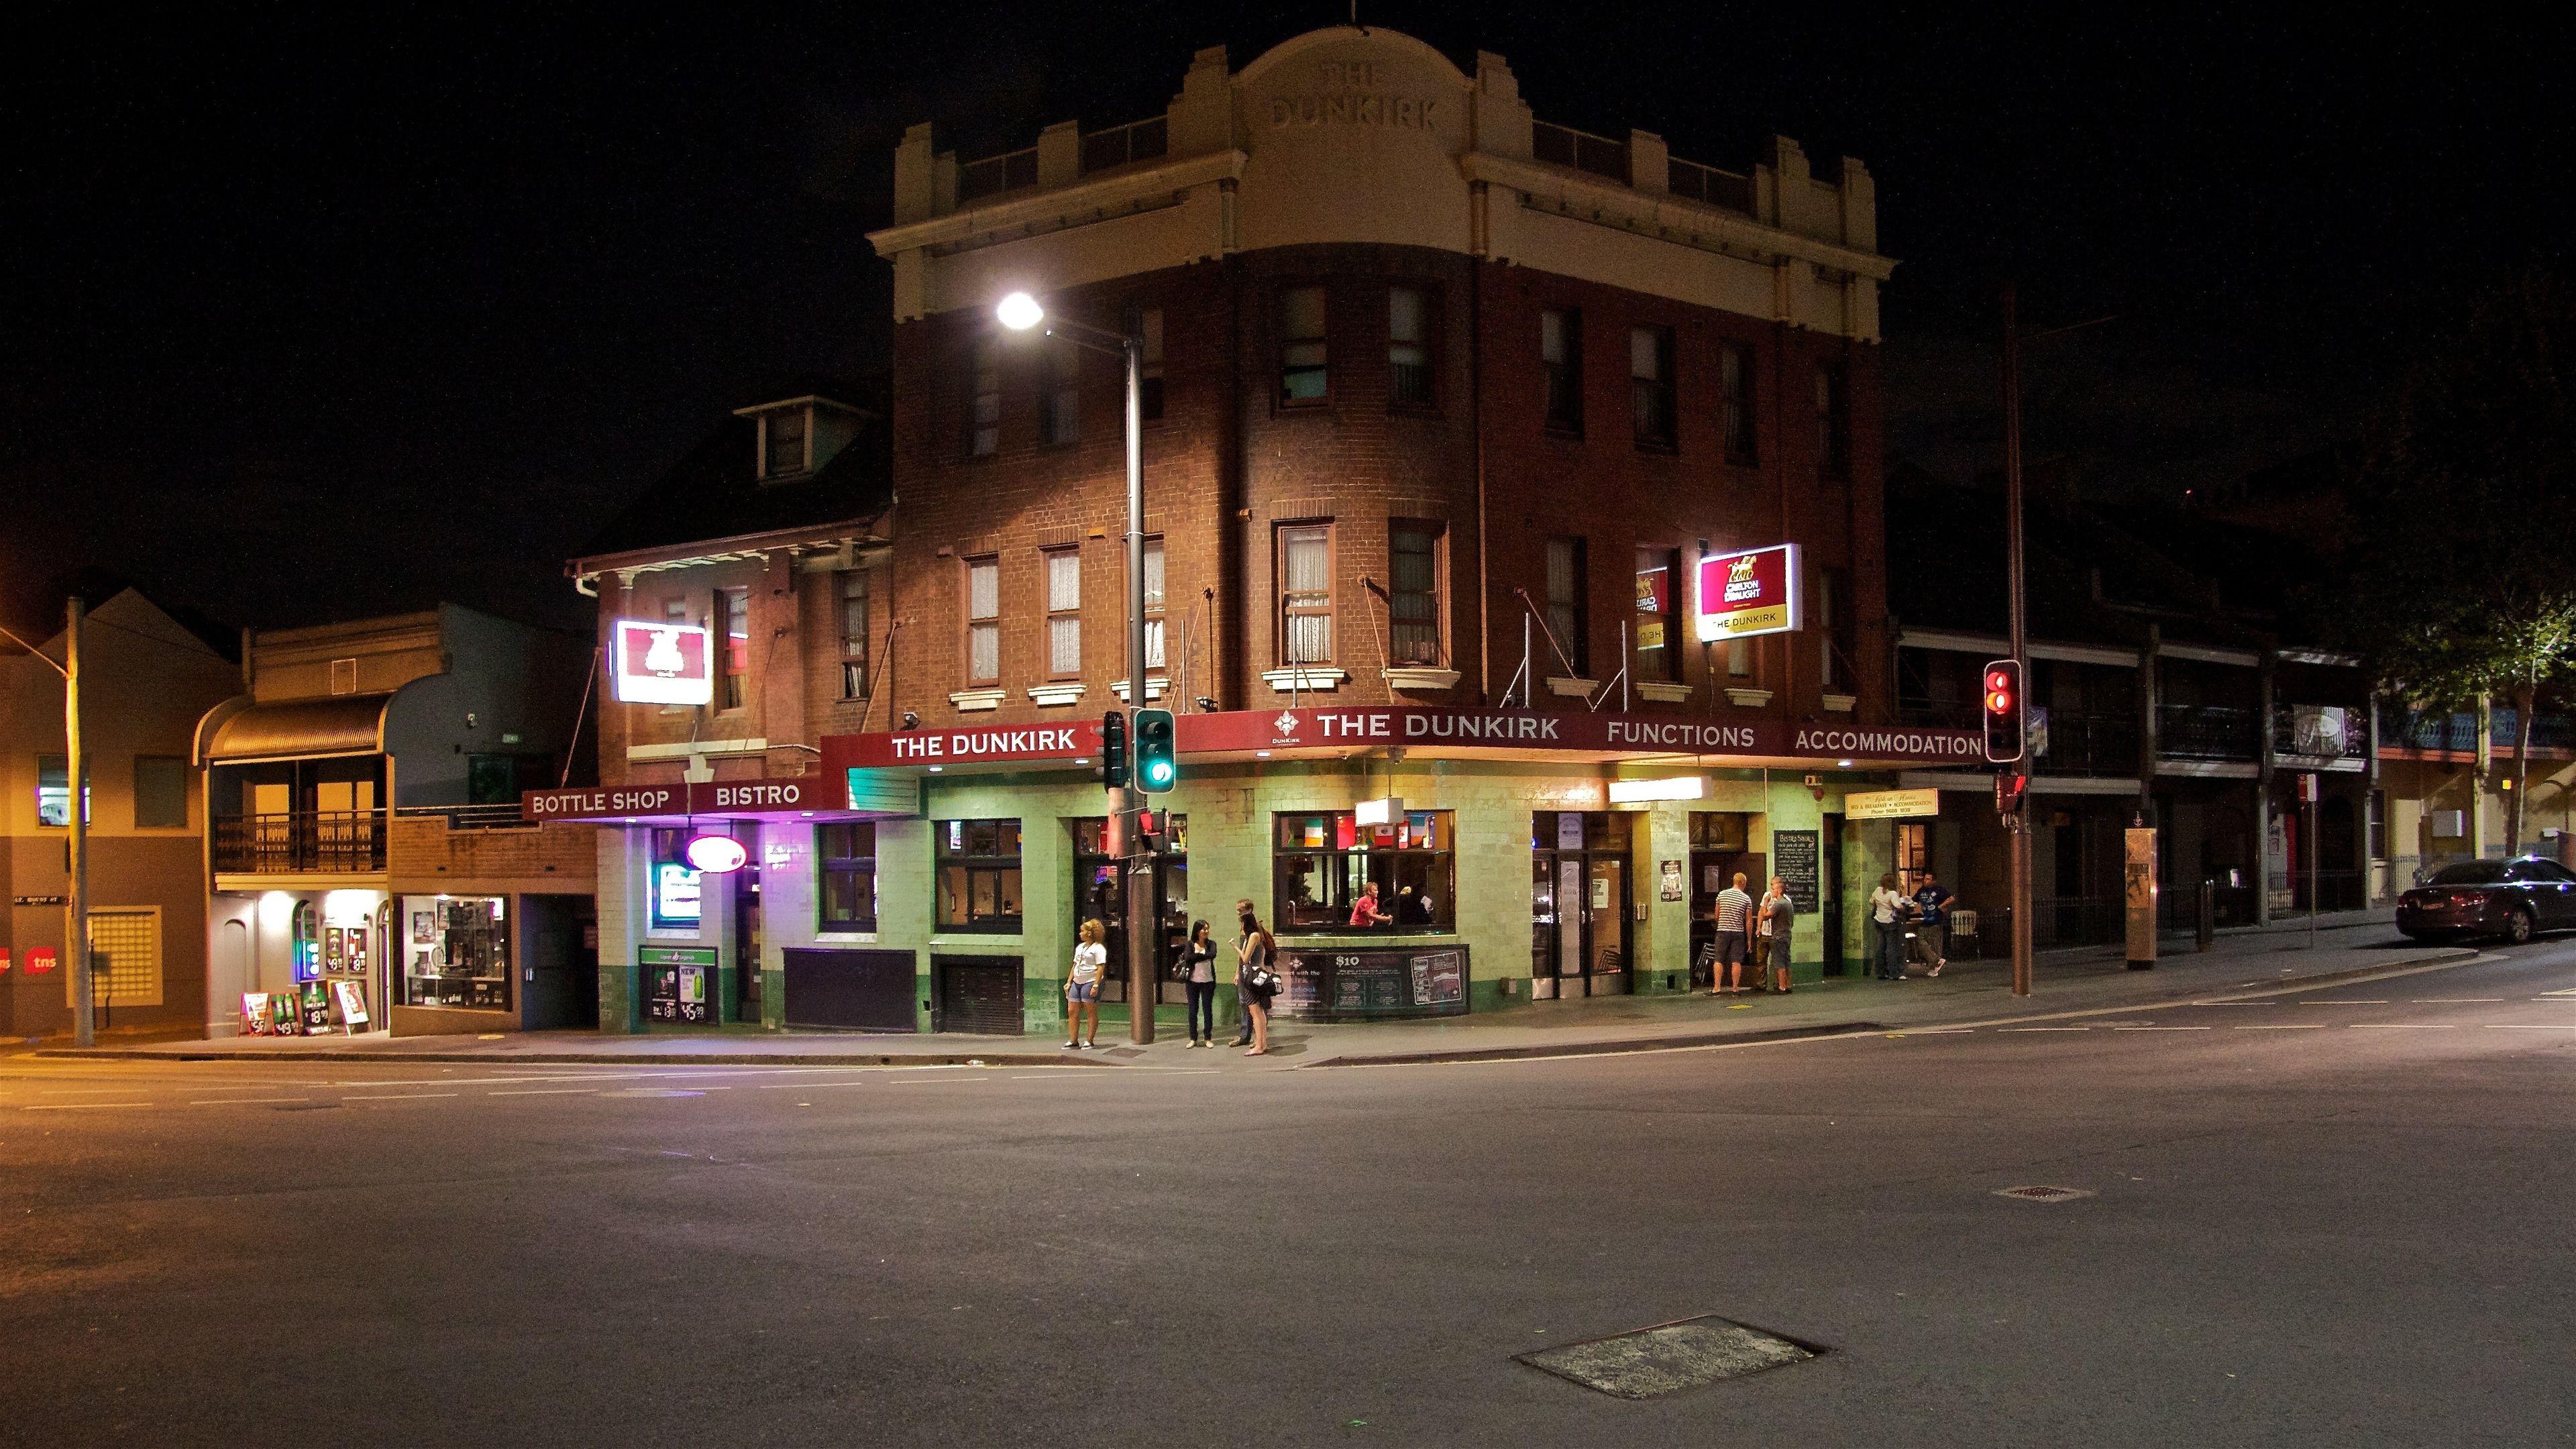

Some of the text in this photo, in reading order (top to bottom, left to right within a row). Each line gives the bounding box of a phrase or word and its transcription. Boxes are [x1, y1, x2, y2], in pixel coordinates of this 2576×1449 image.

[1271, 96, 1436, 129] DUNKIRK
[1733, 613, 1776, 626] DUNKIRK
[1317, 714, 1560, 739] THE DUNKIRK
[1608, 721, 1755, 747] FUNCTIONS
[892, 729, 1076, 757] THE DUNKIRK
[1795, 730, 1982, 755] ACCOMMODATION
[533, 791, 669, 813] BOTTLE SHOP
[717, 785, 800, 806] BISTRO
[34, 957, 56, 967] tns
[1336, 955, 1359, 967] $10
